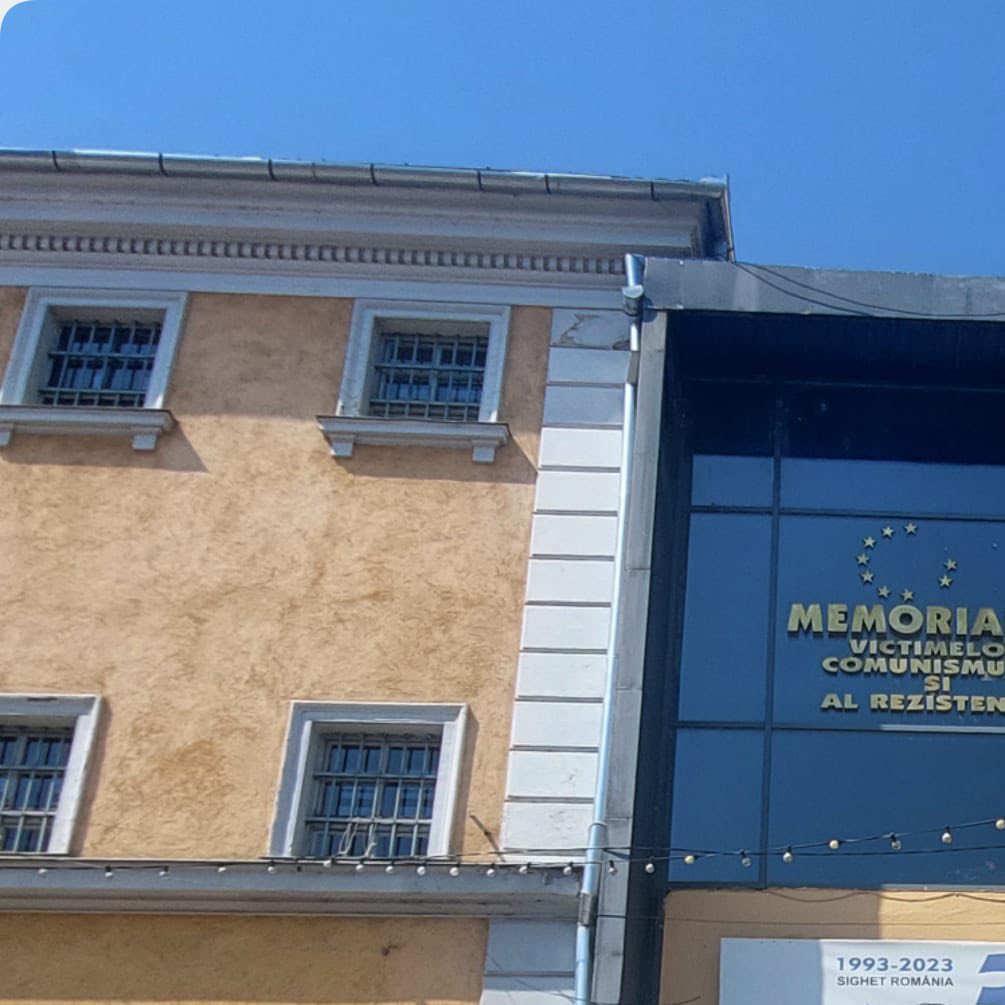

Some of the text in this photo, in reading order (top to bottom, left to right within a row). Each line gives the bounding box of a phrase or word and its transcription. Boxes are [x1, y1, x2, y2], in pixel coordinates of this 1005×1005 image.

[820, 693, 859, 711] AL
[836, 957, 954, 972] 1993-2023
[836, 974, 955, 987] SIGHET ROMÂNIA
